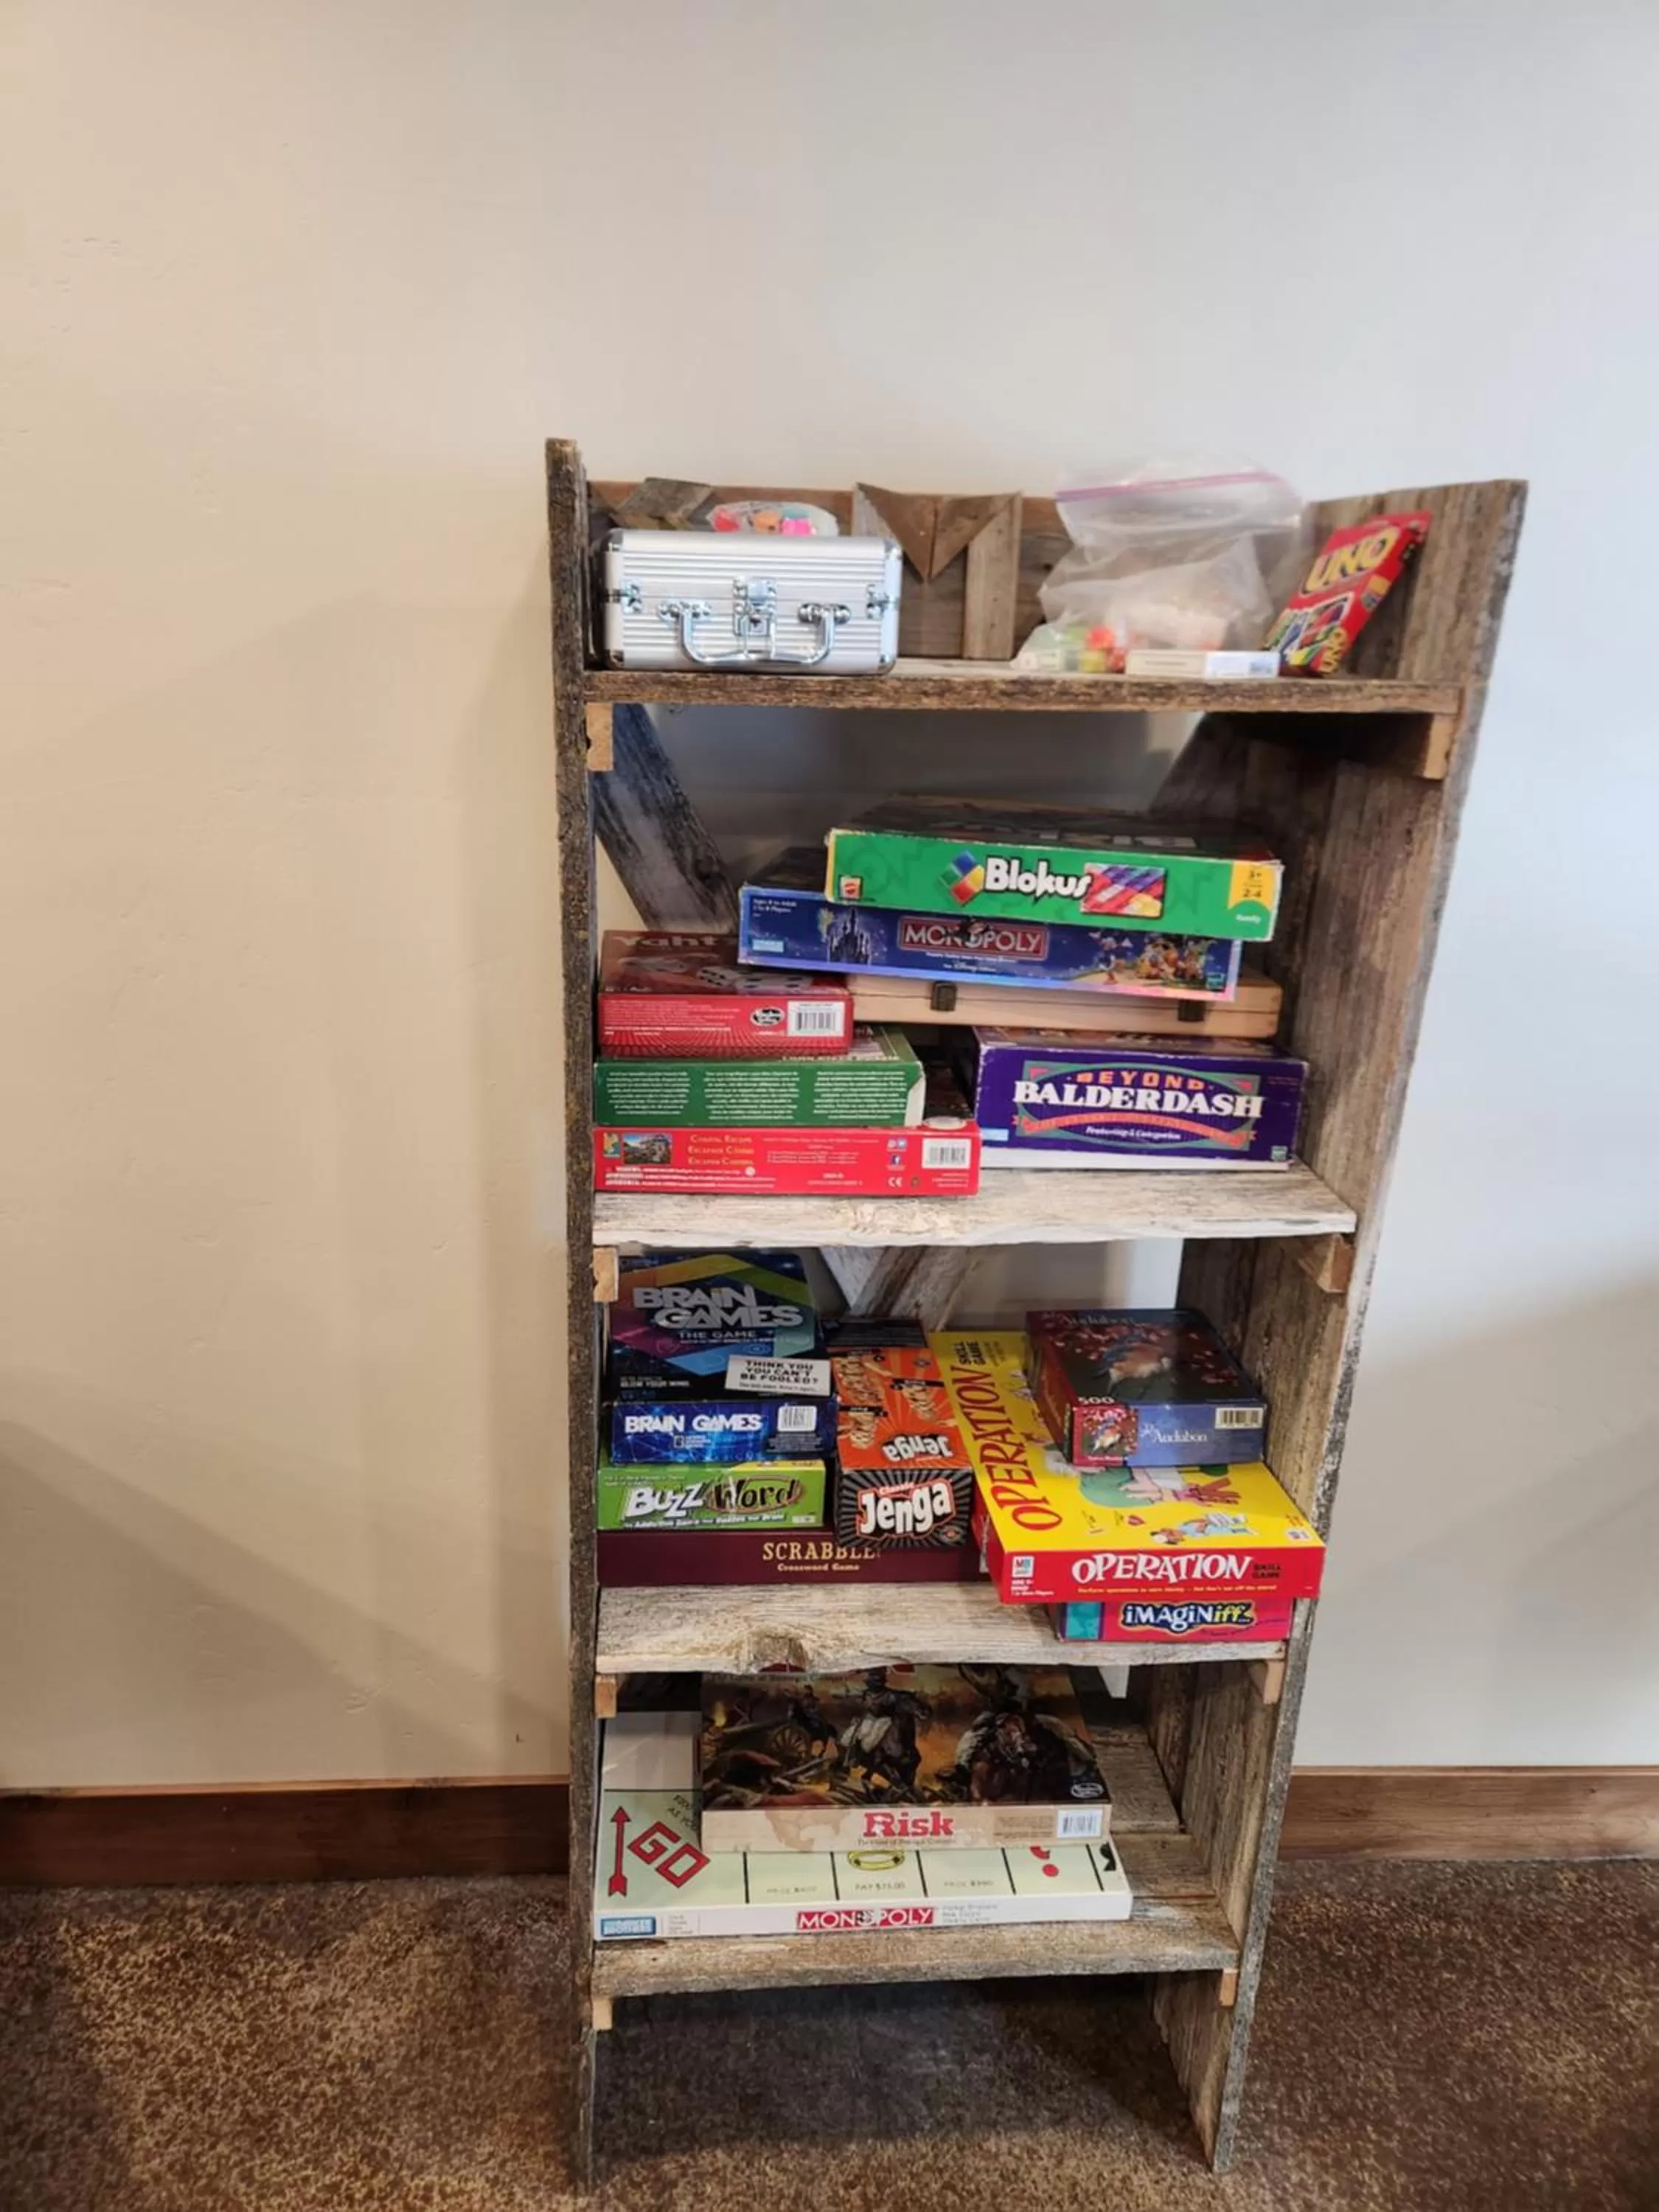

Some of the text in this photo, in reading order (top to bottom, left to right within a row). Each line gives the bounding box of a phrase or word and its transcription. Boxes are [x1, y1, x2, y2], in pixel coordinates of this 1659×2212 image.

[1301, 525, 1399, 596] UNO
[985, 858, 1092, 897] Blokus
[905, 924, 1041, 952] MONOPOLY
[1076, 1070, 1205, 1091] BEYOND
[1013, 1080, 1265, 1119] BALDERDASH
[633, 1284, 757, 1309] BRAIN
[654, 1305, 804, 1328] GAMES
[745, 1360, 784, 1368] THINK
[1077, 1397, 1115, 1405] 500
[625, 1413, 762, 1433] BRAIN GAMES
[882, 1435, 953, 1462] Jenga
[950, 1364, 1062, 1531] OPERATION
[714, 1478, 796, 1509] Word
[860, 1482, 952, 1534] Jenga
[762, 1541, 875, 1560] SCRABBLE
[1071, 1552, 1253, 1585] OPERATION
[863, 1810, 954, 1837] Risk
[627, 1820, 711, 1888] GO
[799, 1907, 932, 1930] MONOPOLY
